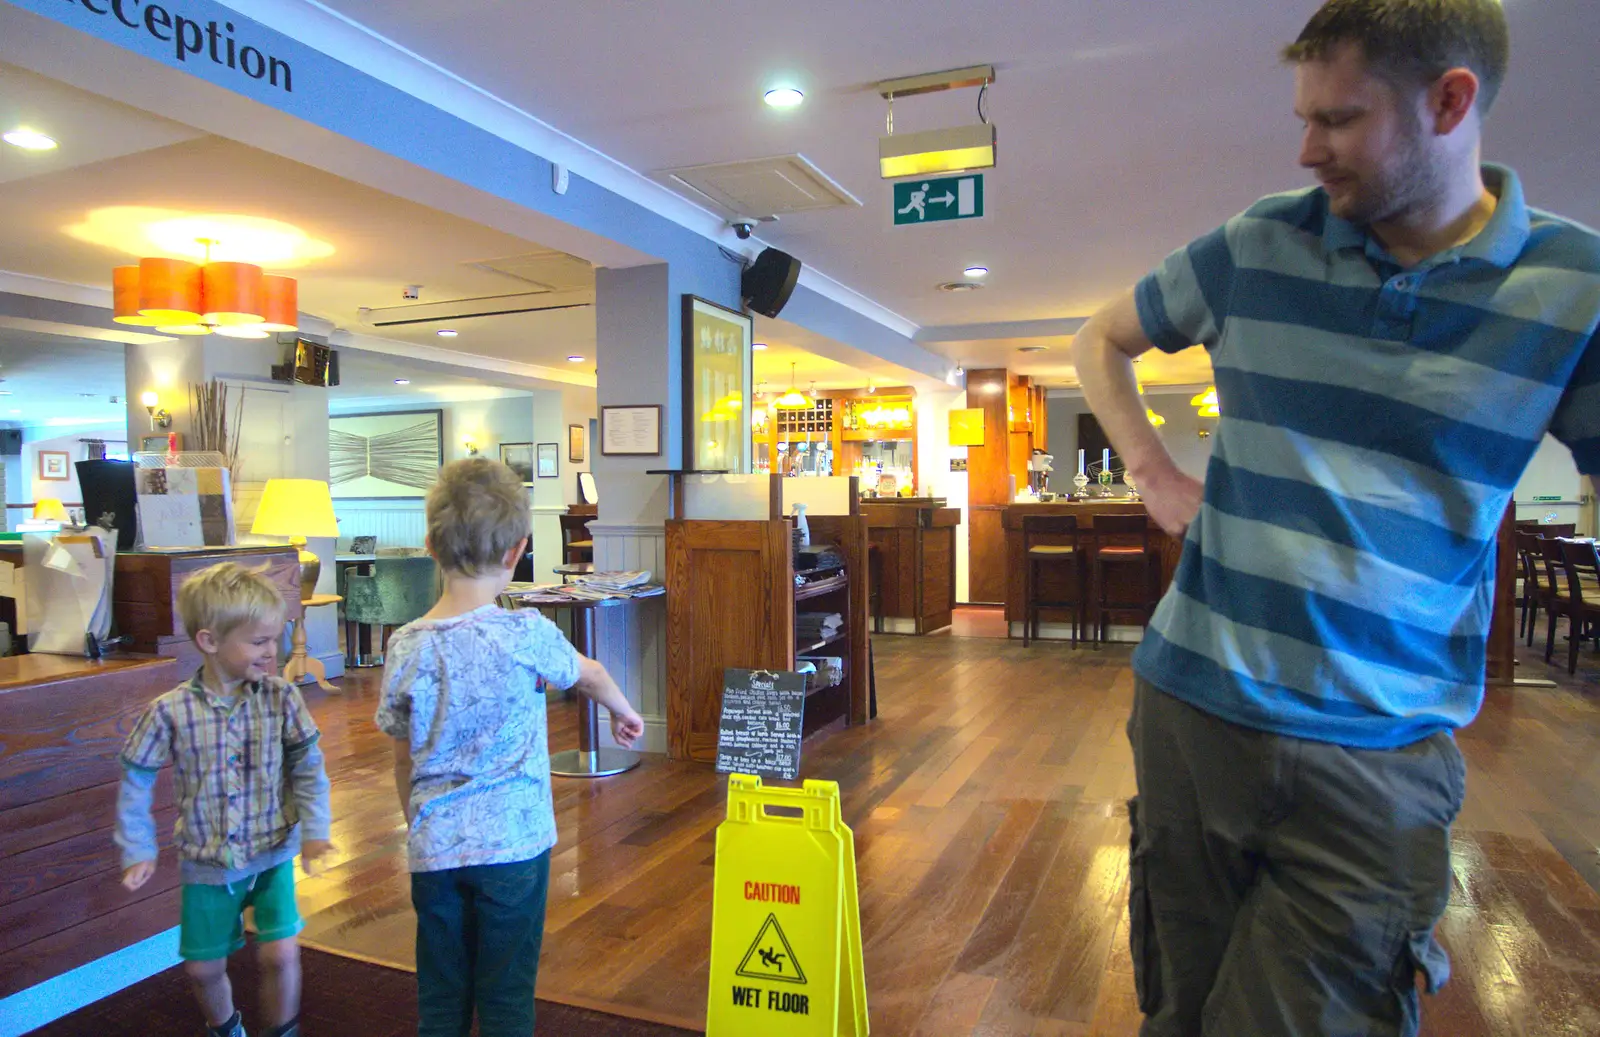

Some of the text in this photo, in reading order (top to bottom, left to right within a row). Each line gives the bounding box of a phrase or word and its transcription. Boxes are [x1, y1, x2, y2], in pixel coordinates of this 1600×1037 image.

[744, 880, 800, 904] CAUTION
[732, 986, 809, 1015] WET FLOOR
